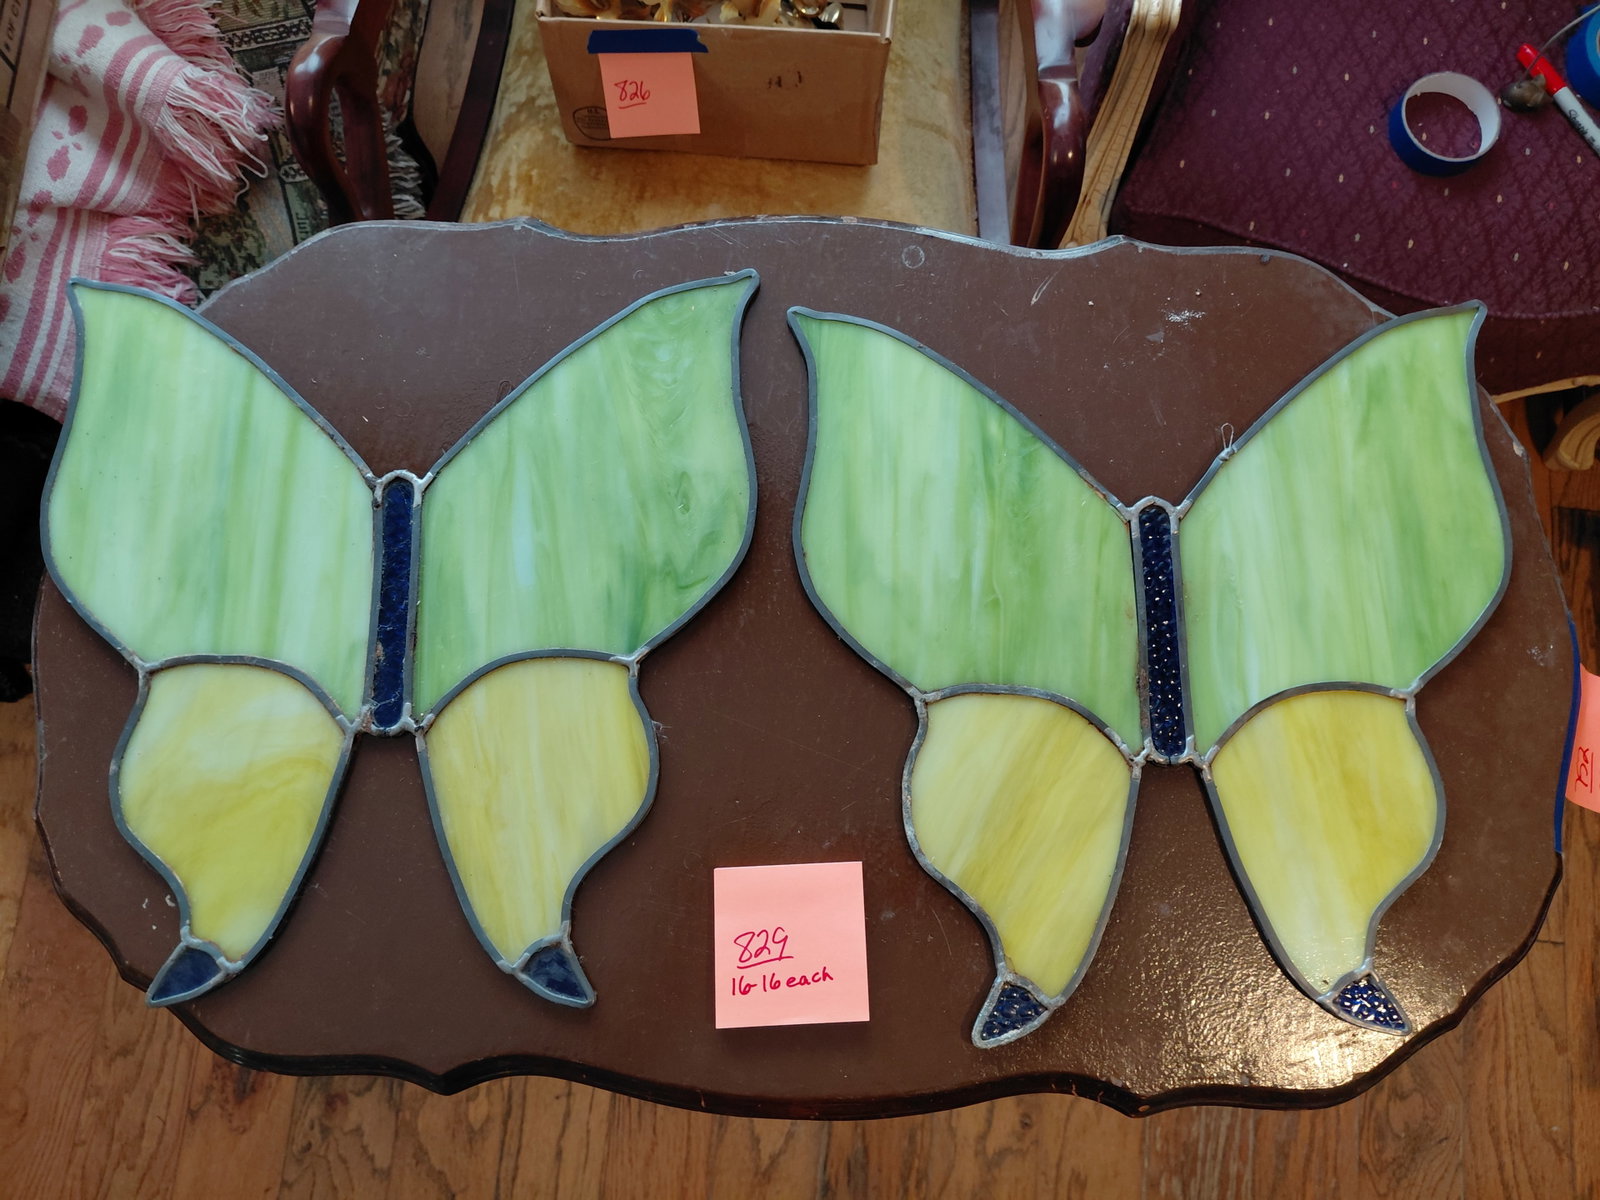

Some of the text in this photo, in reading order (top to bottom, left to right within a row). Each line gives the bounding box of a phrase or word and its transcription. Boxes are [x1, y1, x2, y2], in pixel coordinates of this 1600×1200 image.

[614, 80, 651, 101] 826
[733, 926, 789, 963] 829
[786, 966, 834, 988] each
